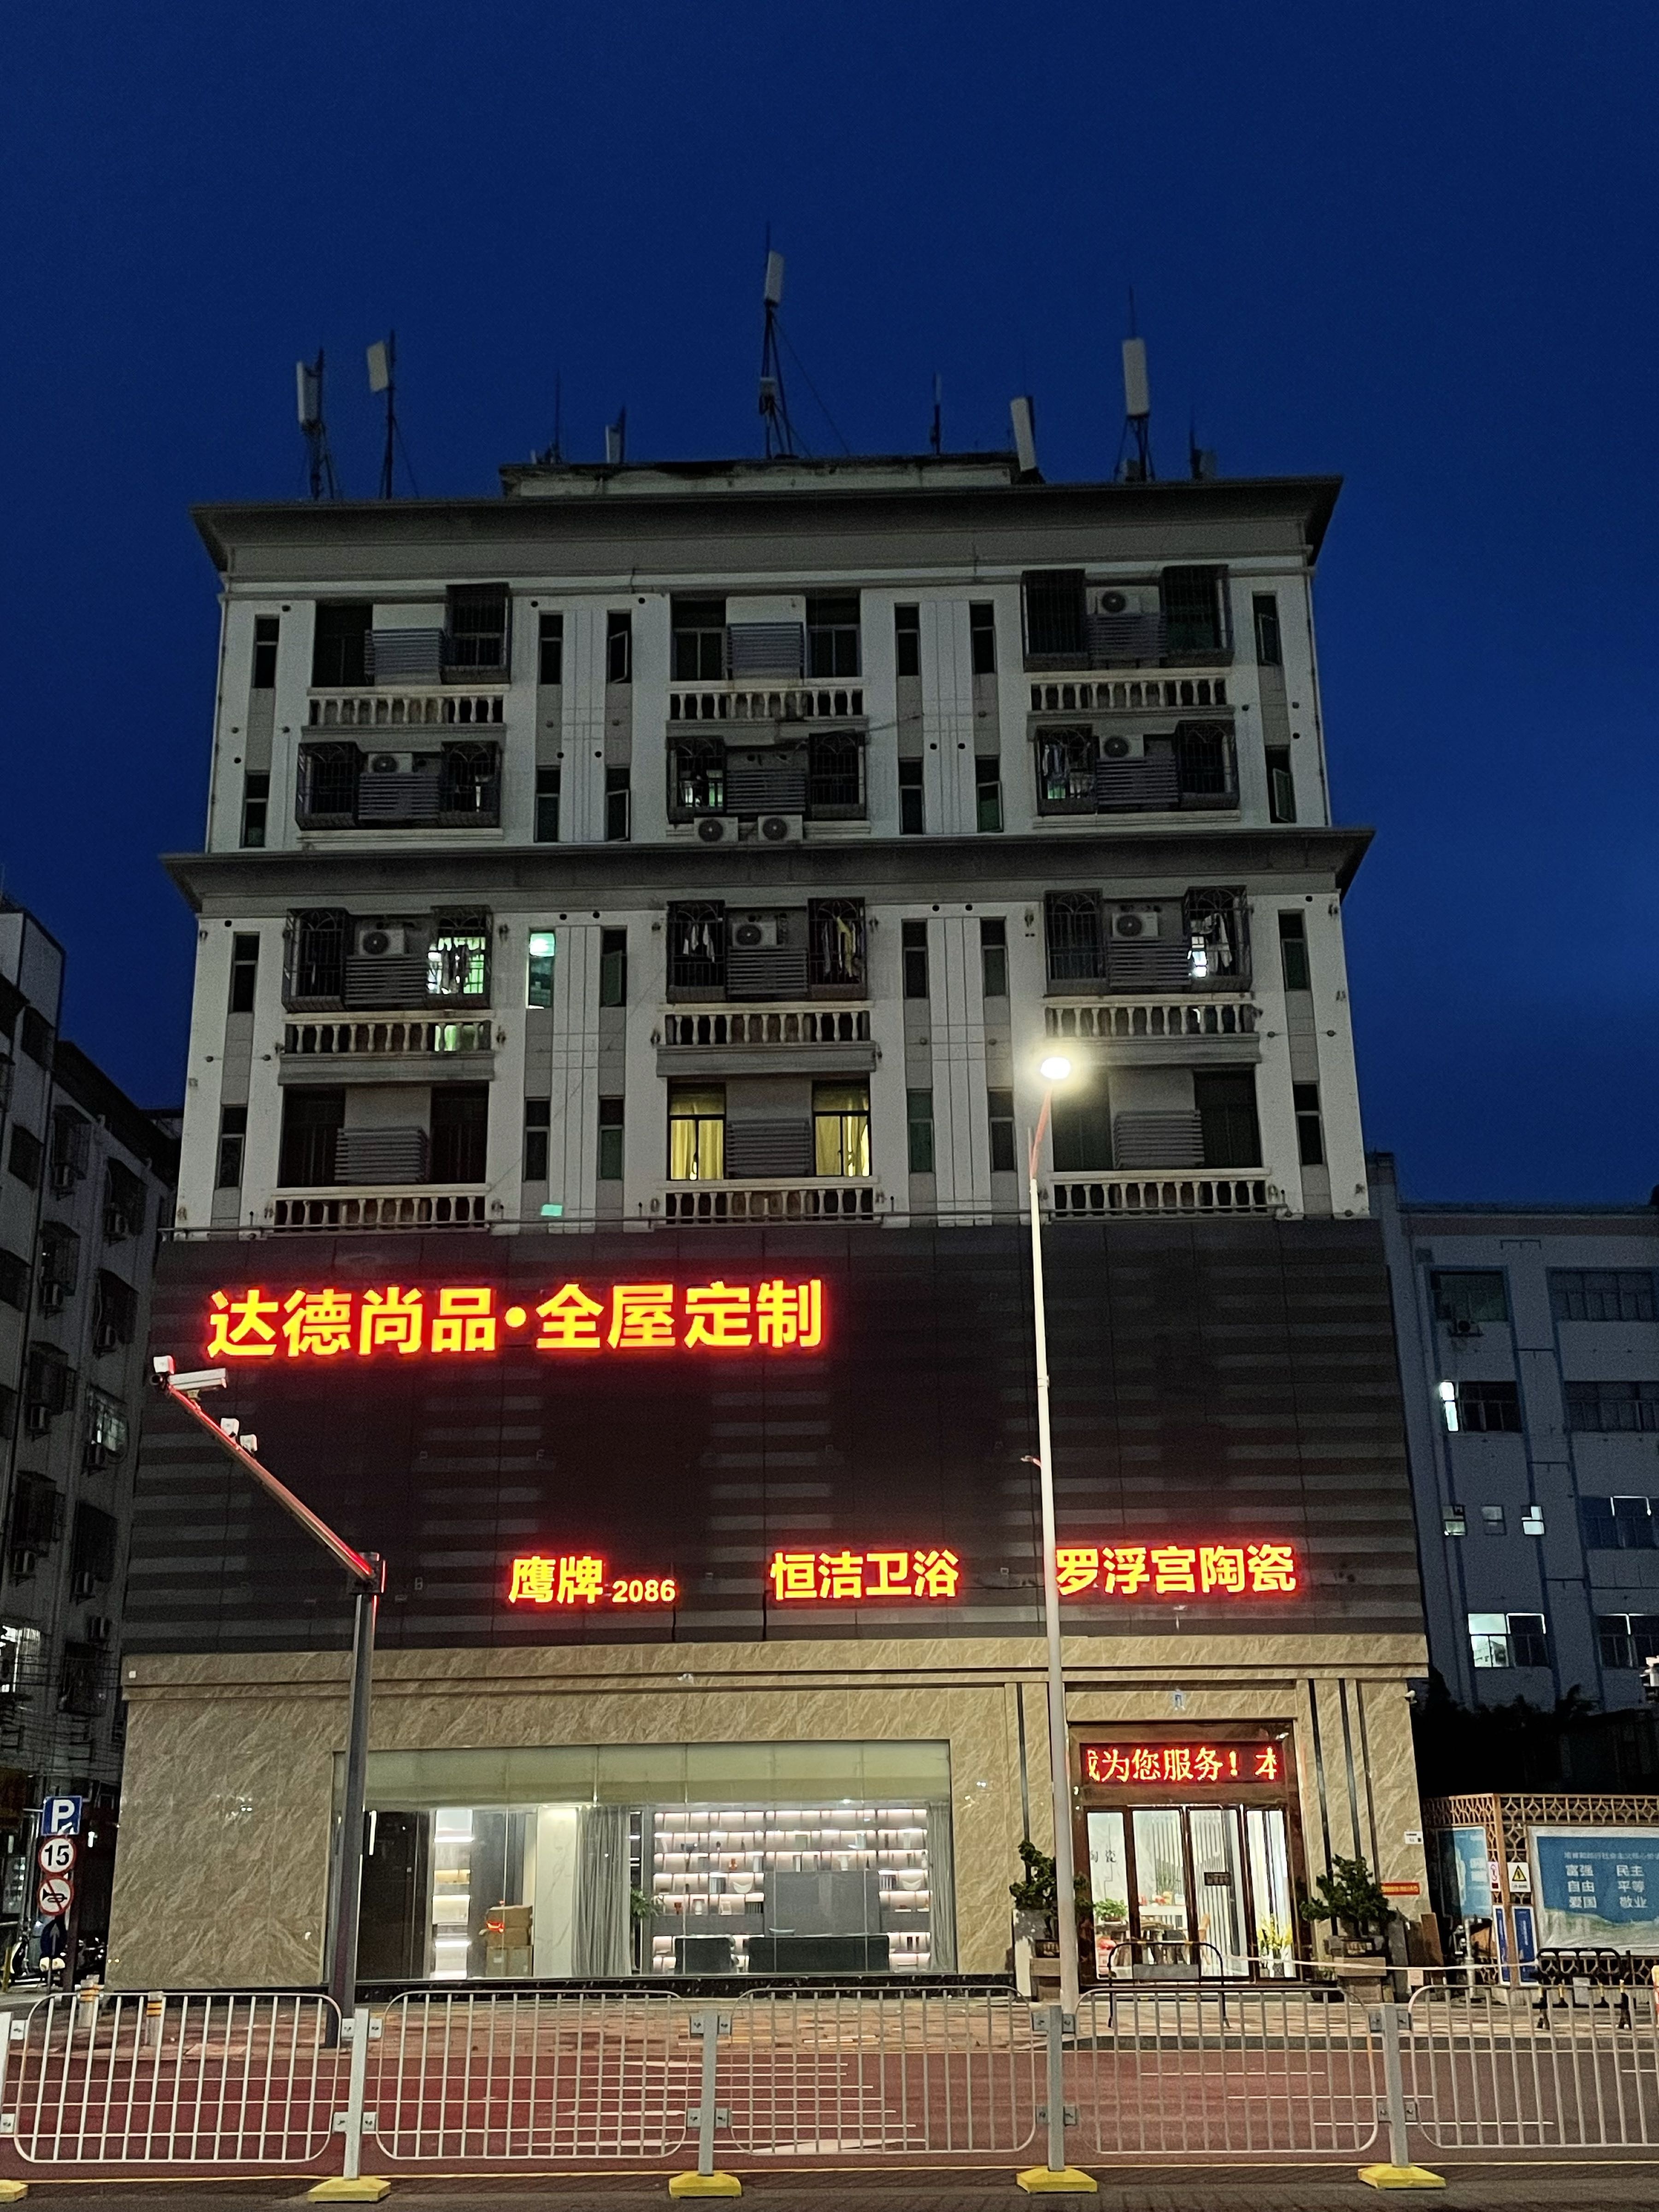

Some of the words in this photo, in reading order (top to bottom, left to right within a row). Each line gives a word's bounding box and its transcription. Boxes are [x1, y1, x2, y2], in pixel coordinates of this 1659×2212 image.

[770, 1549, 959, 1600] 恒洁卫浴
[1056, 1544, 1296, 1596] 罗浮宫陶瓷
[51, 1800, 75, 1833] P
[45, 1845, 69, 1866] 15
[1616, 1865, 1644, 1877] 民主
[1568, 1880, 1594, 1893] 自由
[1618, 1881, 1645, 1893] 平等
[1569, 1896, 1597, 1908] 爱国
[1619, 1895, 1648, 1908] 敬业
